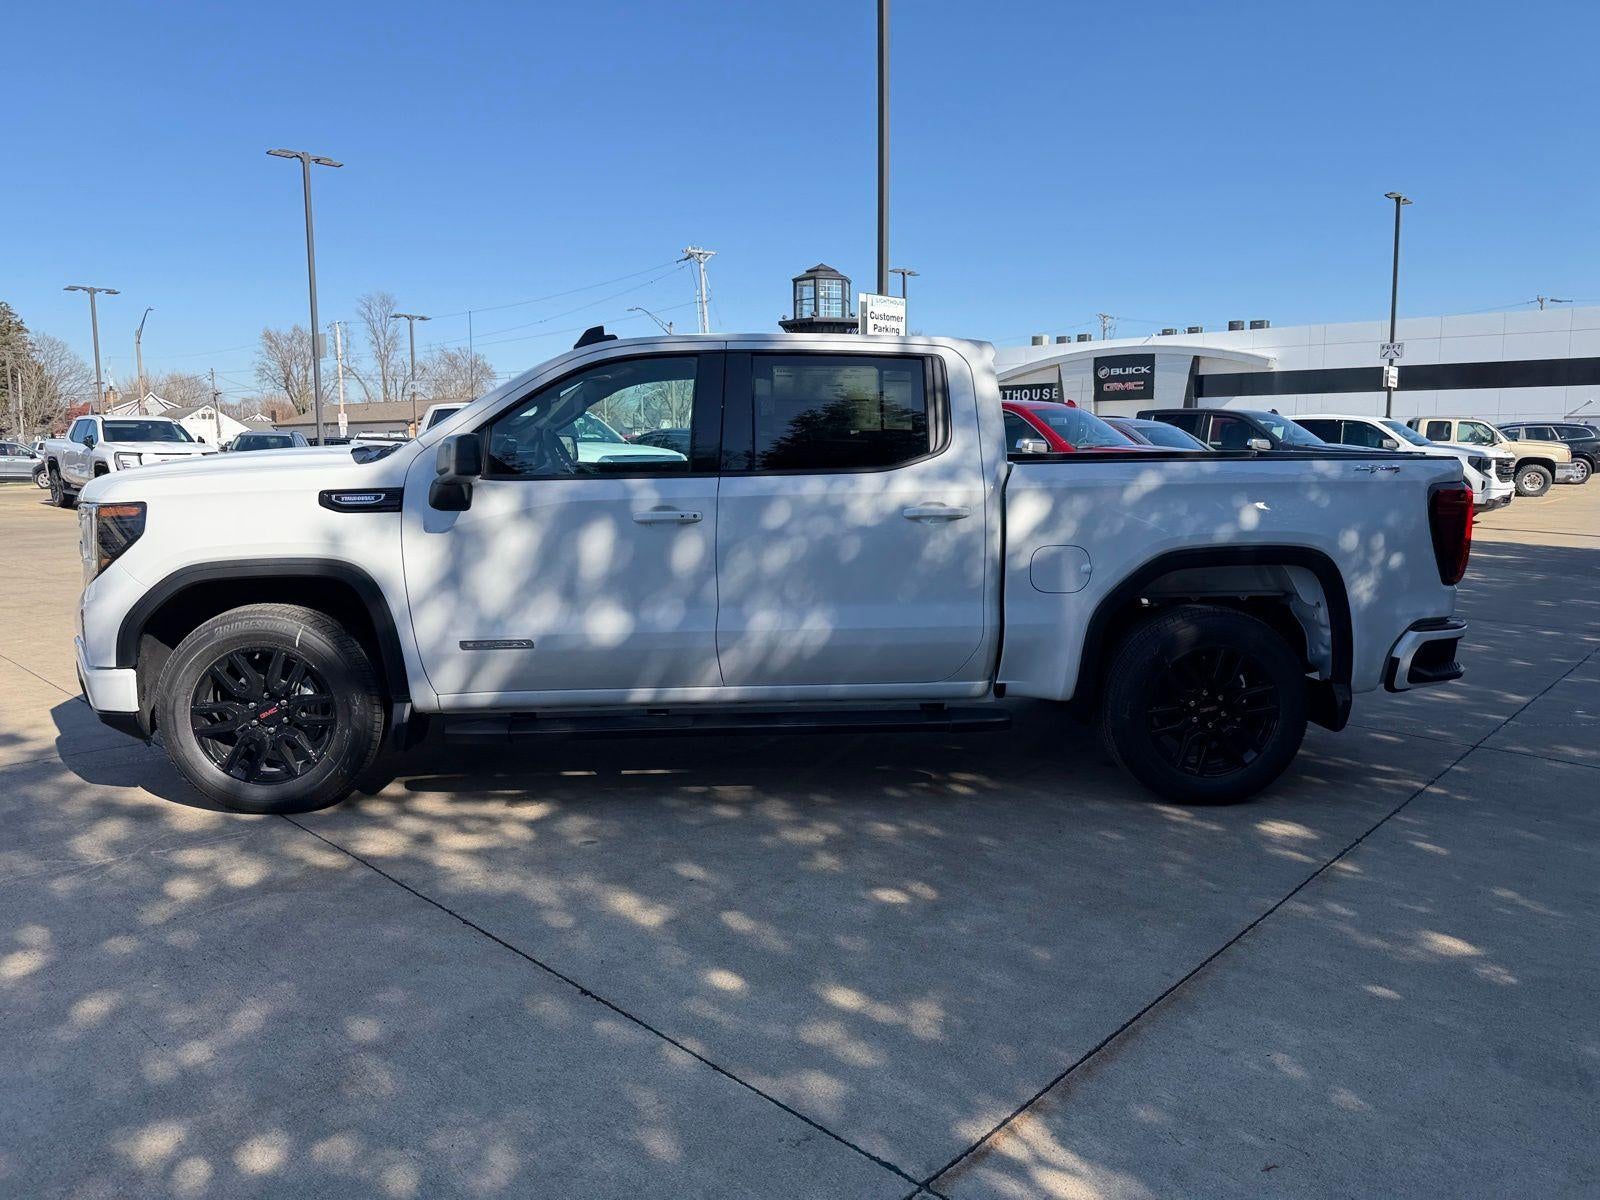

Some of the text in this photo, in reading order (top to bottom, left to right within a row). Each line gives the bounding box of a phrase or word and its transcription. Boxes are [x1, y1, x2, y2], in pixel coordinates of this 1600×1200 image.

[870, 311, 903, 322] Customer
[873, 324, 899, 336] Parking
[1110, 365, 1152, 375] BUICK
[1103, 381, 1144, 392] GMC
[259, 707, 278, 719] GMC
